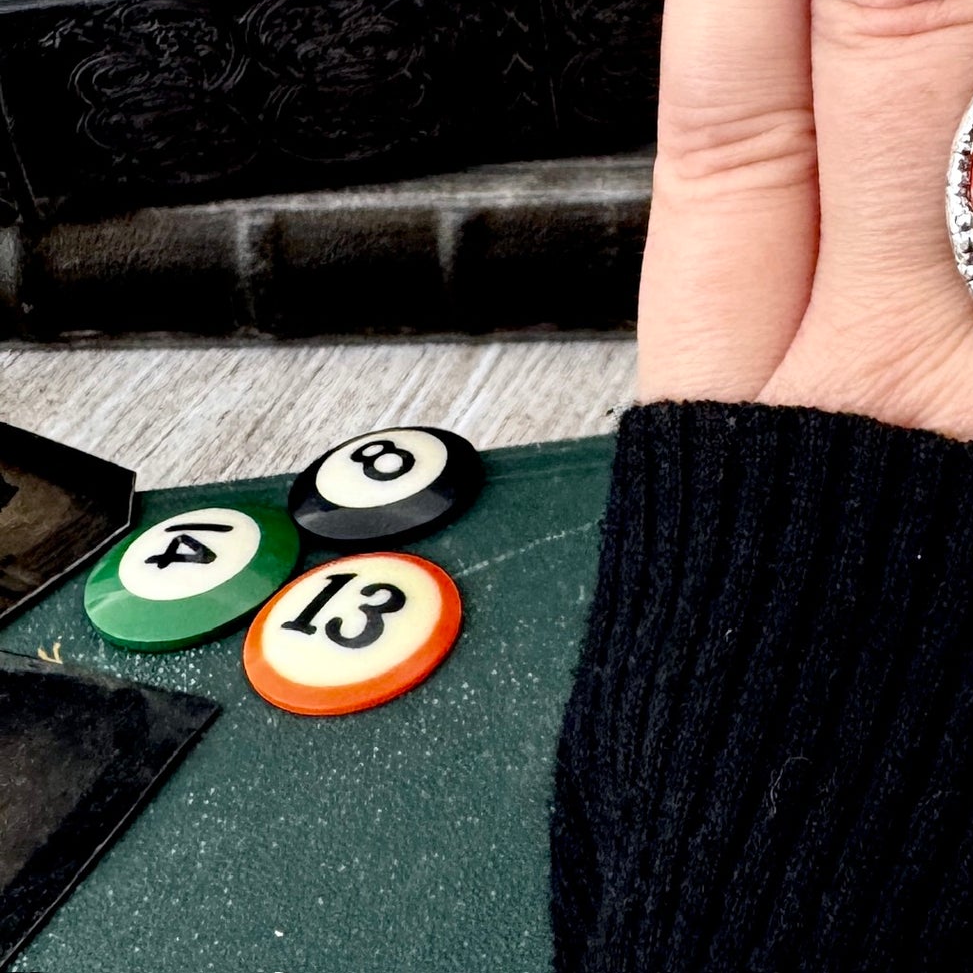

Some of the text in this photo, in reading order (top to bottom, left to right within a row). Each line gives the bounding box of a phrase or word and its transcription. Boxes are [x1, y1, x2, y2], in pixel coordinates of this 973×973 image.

[350, 440, 416, 482] 8
[144, 523, 234, 570] 14
[280, 572, 407, 650] 13
